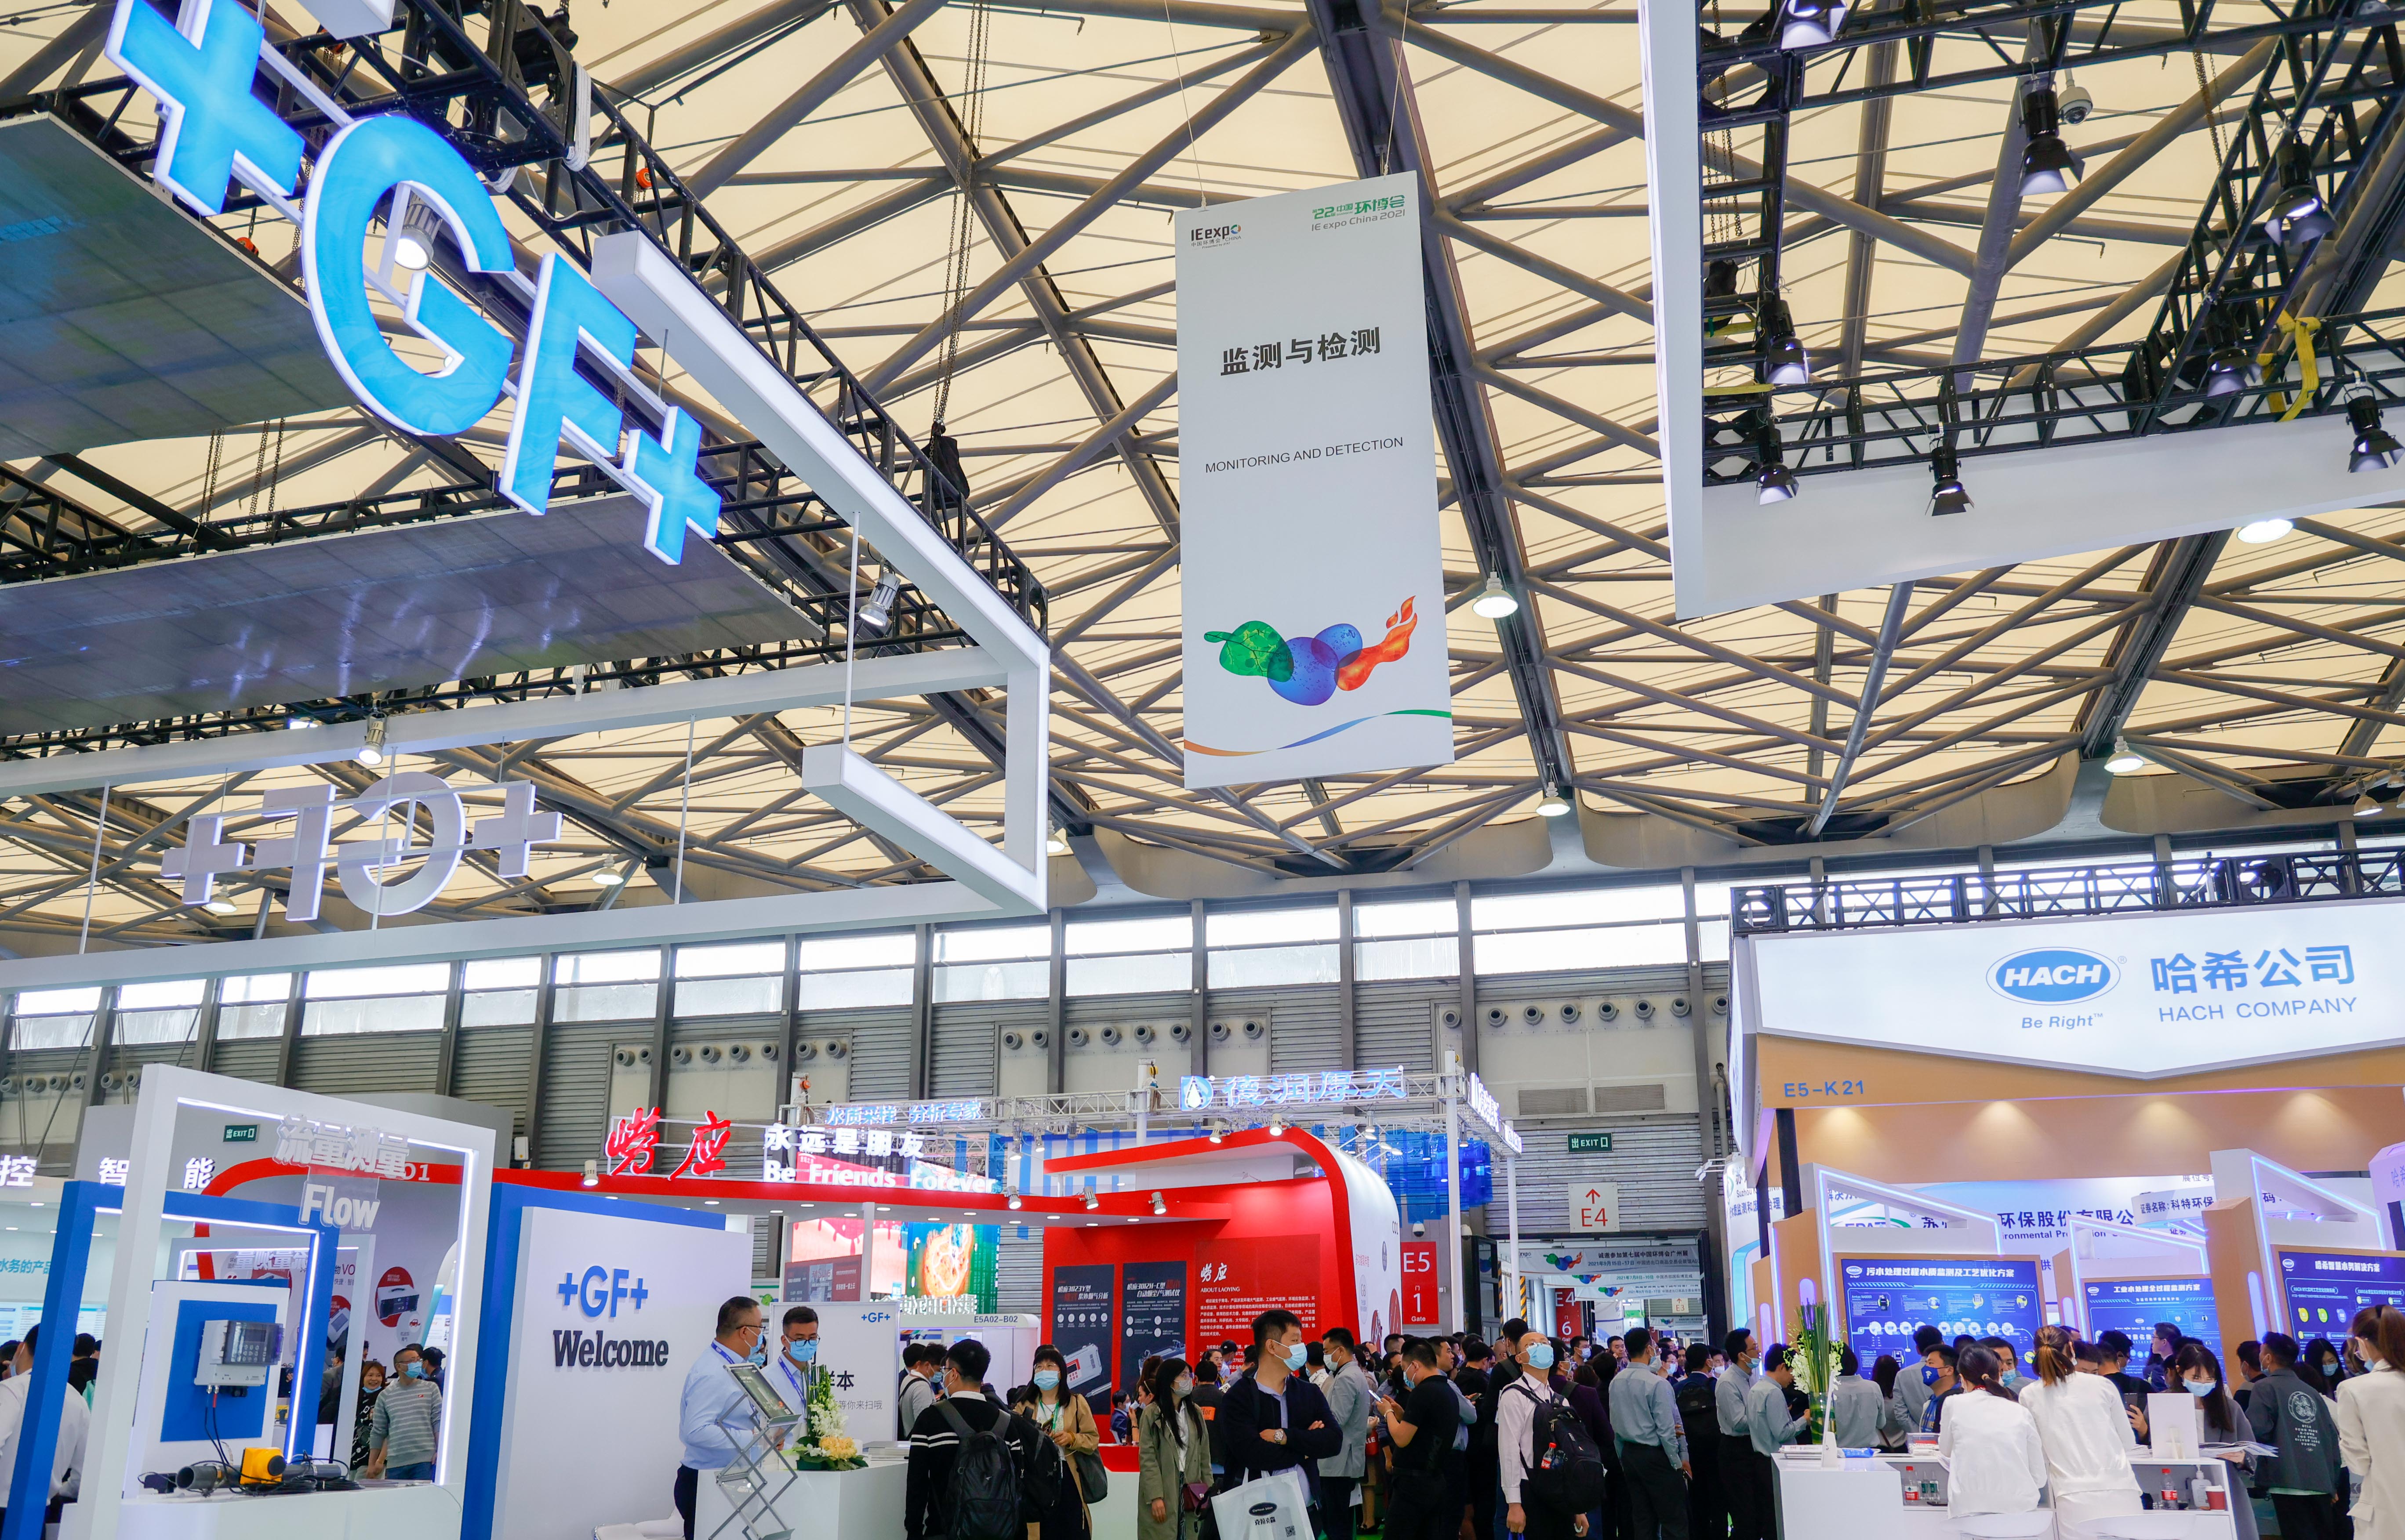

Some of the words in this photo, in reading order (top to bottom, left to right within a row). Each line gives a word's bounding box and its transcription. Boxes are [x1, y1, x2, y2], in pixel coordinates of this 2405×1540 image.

[1323, 221, 1347, 229] expo
[1349, 215, 1378, 225] China
[1380, 209, 1405, 220] 2021
[1192, 238, 1221, 247] 中国环博会
[1220, 326, 1381, 376] 监测与检测
[1206, 453, 1290, 473] MONITORING
[1293, 448, 1321, 461] AND
[1326, 437, 1403, 457] DETECTION
[2003, 964, 2102, 988] HACH
[2151, 945, 2356, 995] 哈希公司
[2158, 1004, 2224, 1022] HACH
[2236, 997, 2358, 1019] COMPANY
[2021, 1016, 2043, 1029] Be
[1222, 1068, 1407, 1107] 德润厚天
[1784, 1080, 1864, 1098] E5-K21
[826, 1105, 897, 1126] 水质采样
[908, 1099, 983, 1124] 分析专家
[272, 1114, 410, 1180] 流量测量
[763, 1123, 925, 1159] 永远是朋友
[0, 1155, 37, 1187] 控
[182, 1157, 215, 1189] 能
[764, 1160, 796, 1183] Be
[809, 1163, 896, 1188] Friends
[910, 1167, 997, 1193] Forever
[1737, 1188, 1752, 1198] Suzhou
[301, 1183, 381, 1230] Flow
[1581, 1207, 1608, 1227] E4
[2002, 1230, 2052, 1239] ironmental
[1403, 1251, 1430, 1273] E5
[1866, 1267, 2015, 1277] 污水处理过程水质监测及工艺优化方案
[2314, 1260, 2380, 1272] 哈希智慧水务解决方案
[1555, 1291, 1575, 1307] E4
[2113, 1284, 2201, 1293] 工业水处理全过程监测方案
[1413, 1293, 1421, 1313] 1
[1562, 1321, 1572, 1335] 6
[553, 1330, 669, 1367] Welcome
[835, 1400, 883, 1410] 等你来扫哦
